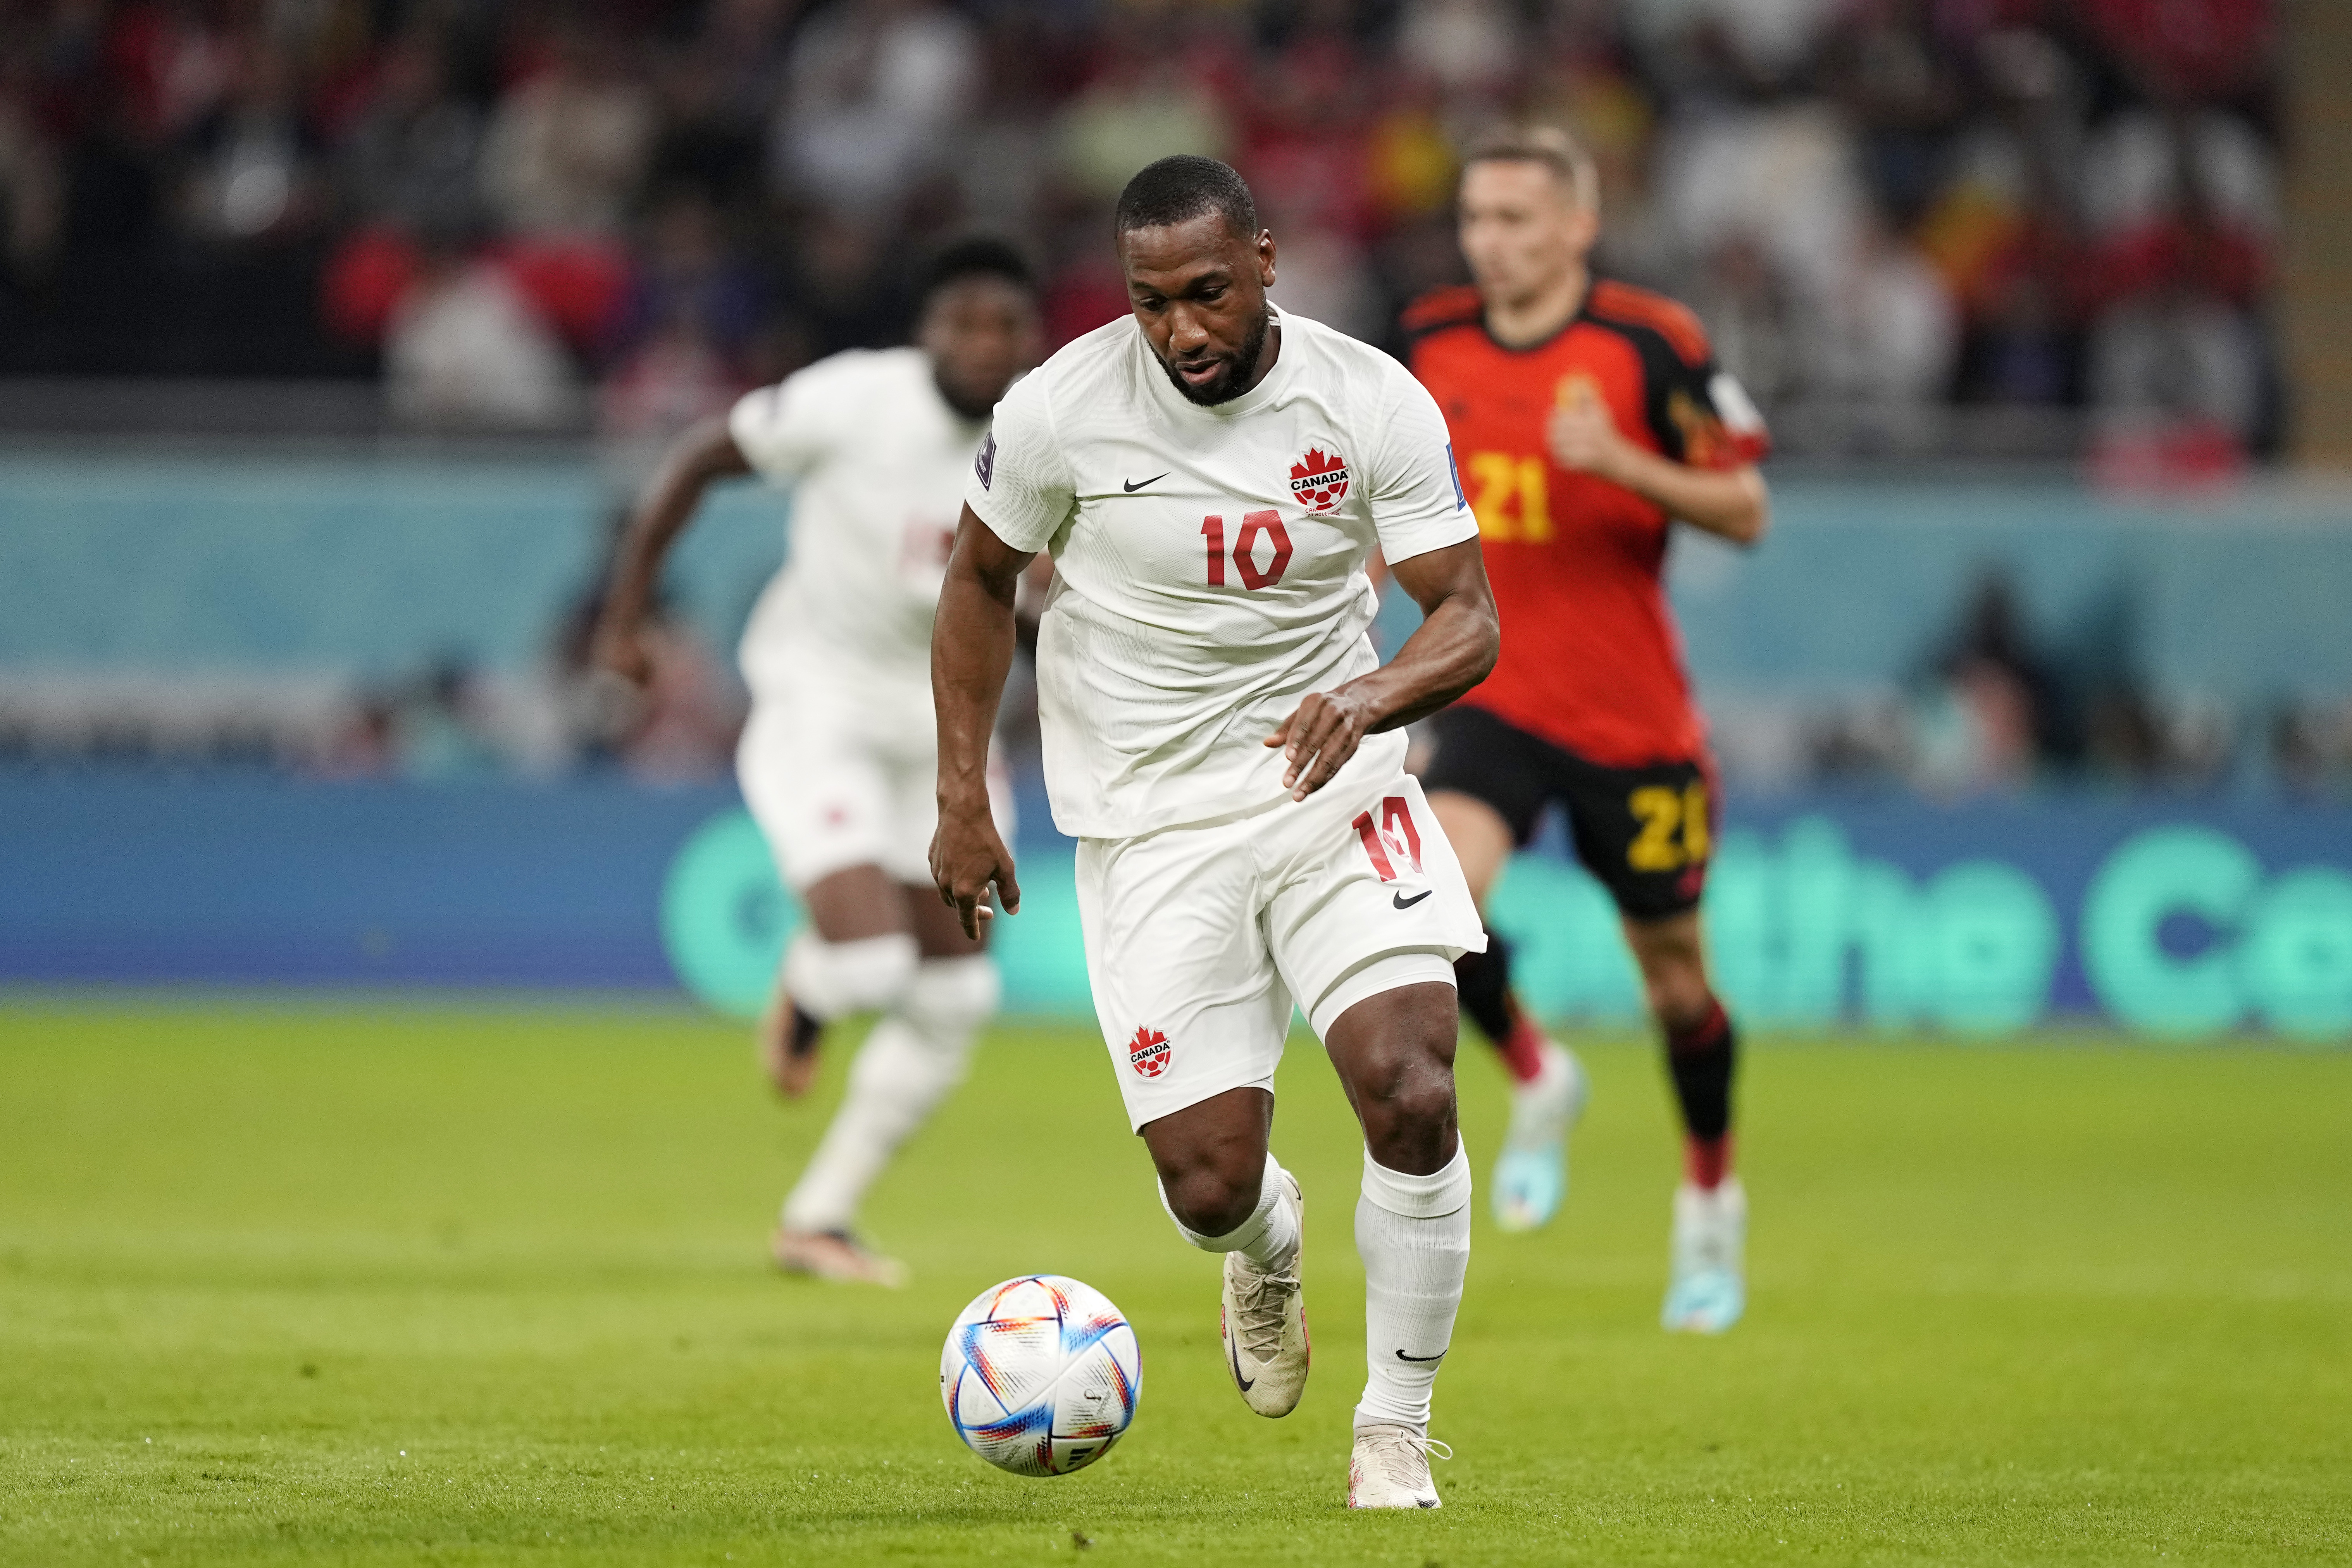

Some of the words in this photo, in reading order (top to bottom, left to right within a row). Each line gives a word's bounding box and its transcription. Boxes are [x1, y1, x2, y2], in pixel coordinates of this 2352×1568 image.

[1291, 470, 1349, 490] CANADA
[1468, 451, 1548, 540] 21
[1201, 509, 1293, 591] 10
[1131, 1042, 1170, 1063] CANADA
